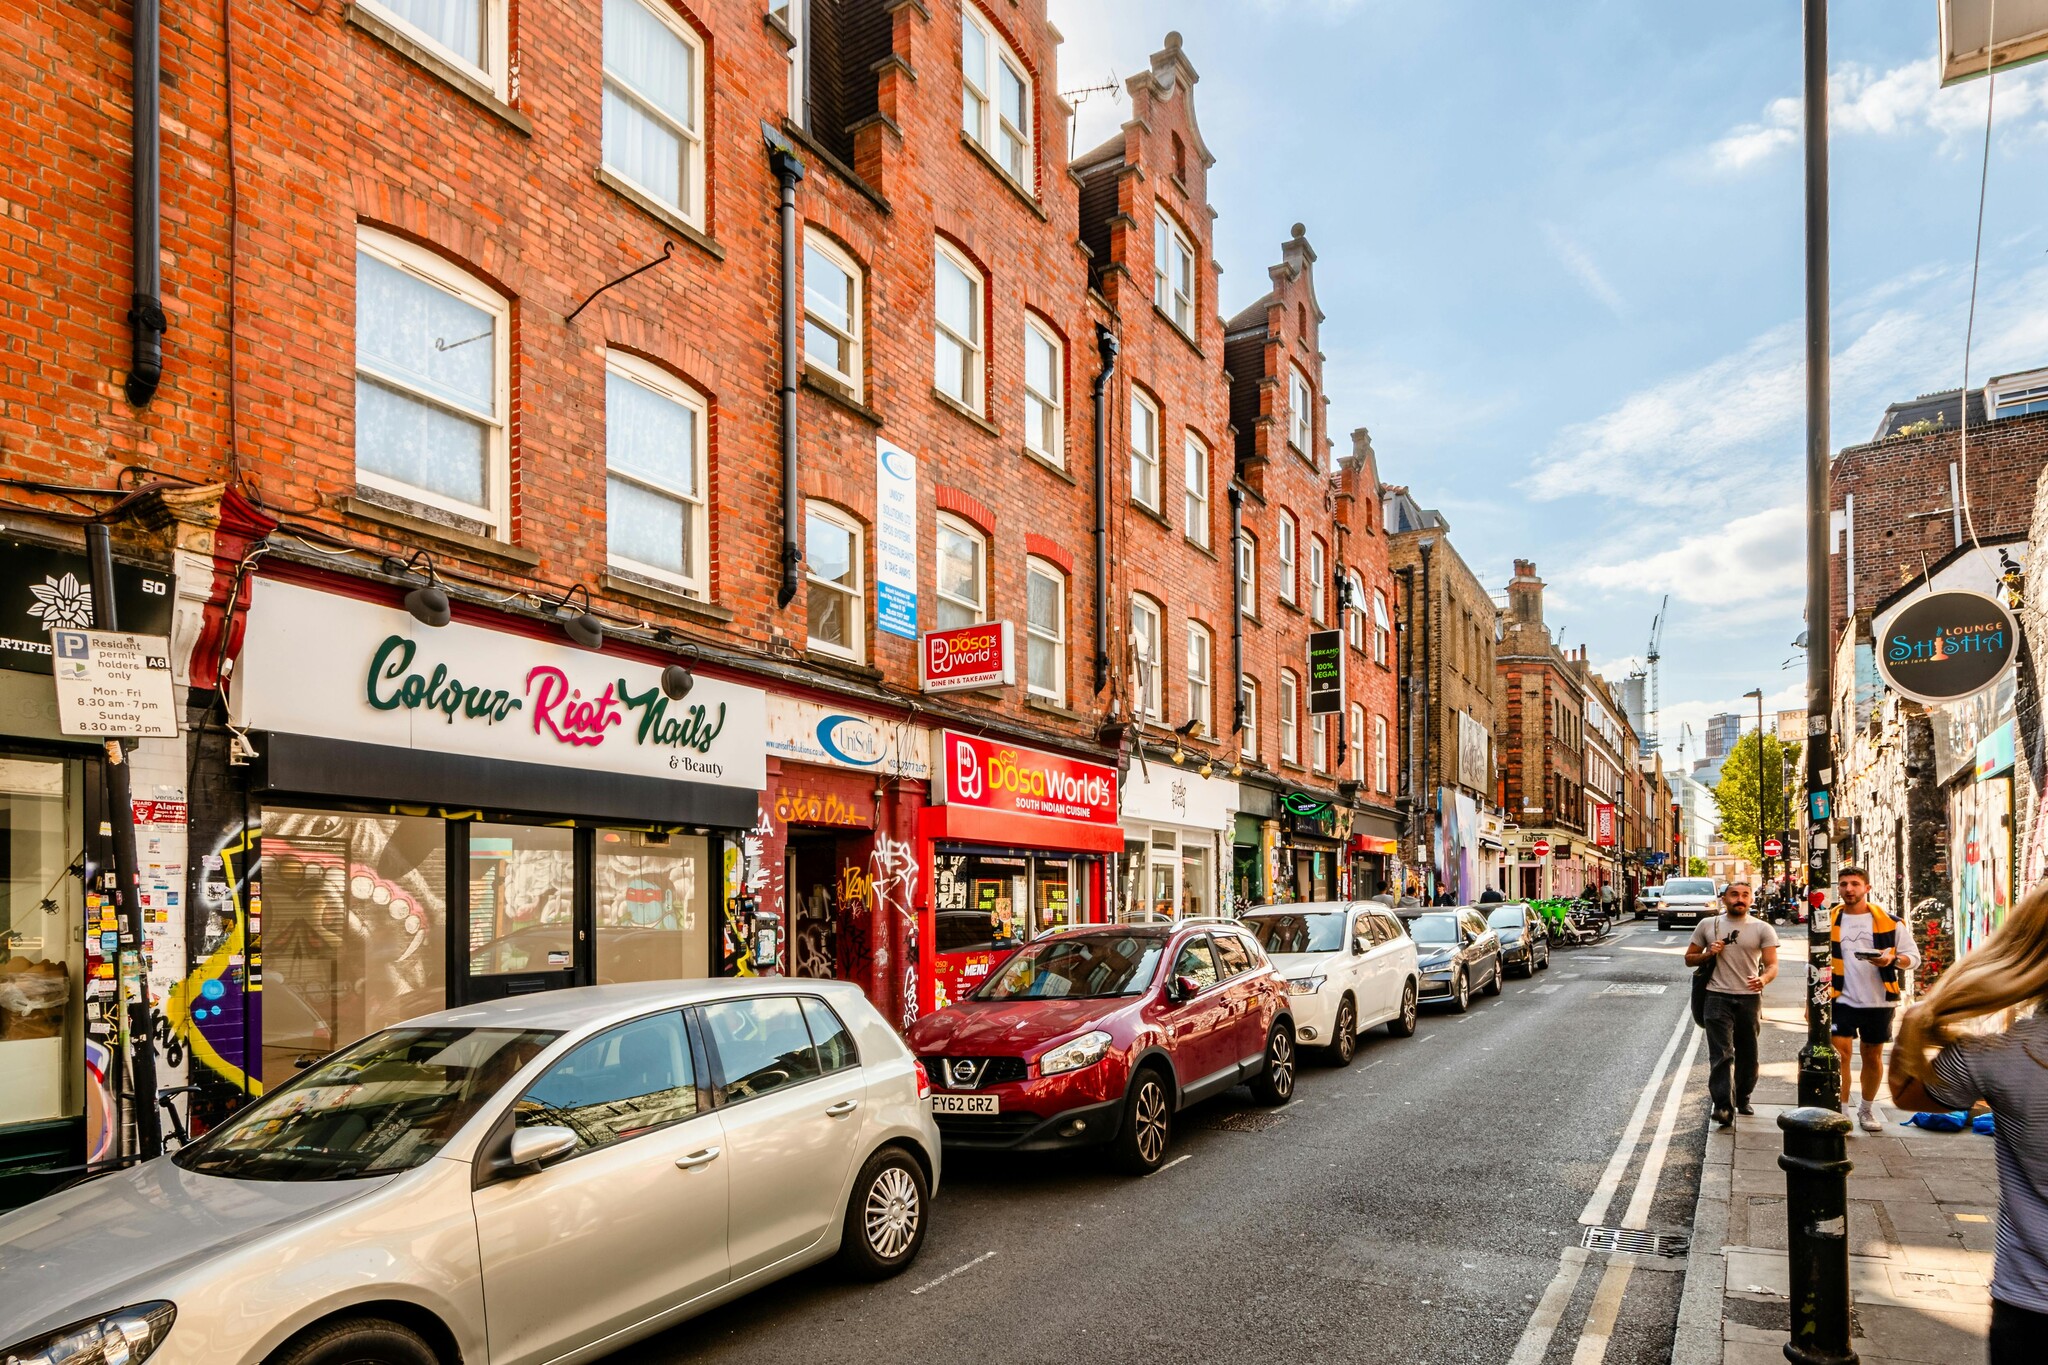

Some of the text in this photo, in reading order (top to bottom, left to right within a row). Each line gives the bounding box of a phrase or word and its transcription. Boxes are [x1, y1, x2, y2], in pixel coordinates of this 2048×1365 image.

[142, 579, 166, 596] 50
[1946, 622, 2003, 636] LOUNGE
[92, 639, 142, 651] Resident
[950, 635, 989, 654] Dosa
[1889, 631, 2004, 661] SHISHA
[99, 651, 136, 661] permit
[954, 648, 990, 665] World
[1310, 648, 1339, 656] MERKAMO
[98, 660, 140, 670] holders
[148, 658, 165, 668] A6
[1316, 662, 1334, 671] 100%
[108, 671, 132, 681] only
[963, 673, 997, 683] TAKEAWAY
[1313, 670, 1338, 679] VEGAN
[93, 687, 118, 696] Mon
[126, 688, 142, 697] Fri
[367, 634, 726, 754] Colour Riot Nails
[77, 698, 105, 707] 8.30
[108, 700, 125, 708] am
[142, 701, 158, 710] pm
[99, 711, 141, 722] Sunday
[79, 722, 107, 731] 8.30
[110, 724, 127, 732] am
[135, 724, 142, 732] 2
[145, 725, 161, 734] pm
[840, 726, 875, 754] UniSoft
[669, 755, 724, 779] & Beauty
[155, 802, 186, 811] Alarm
[1015, 797, 1091, 818] SOUTH INDIAN CUISINE
[964, 963, 989, 977] MENU
[932, 1096, 994, 1112] FY62 GRZ
